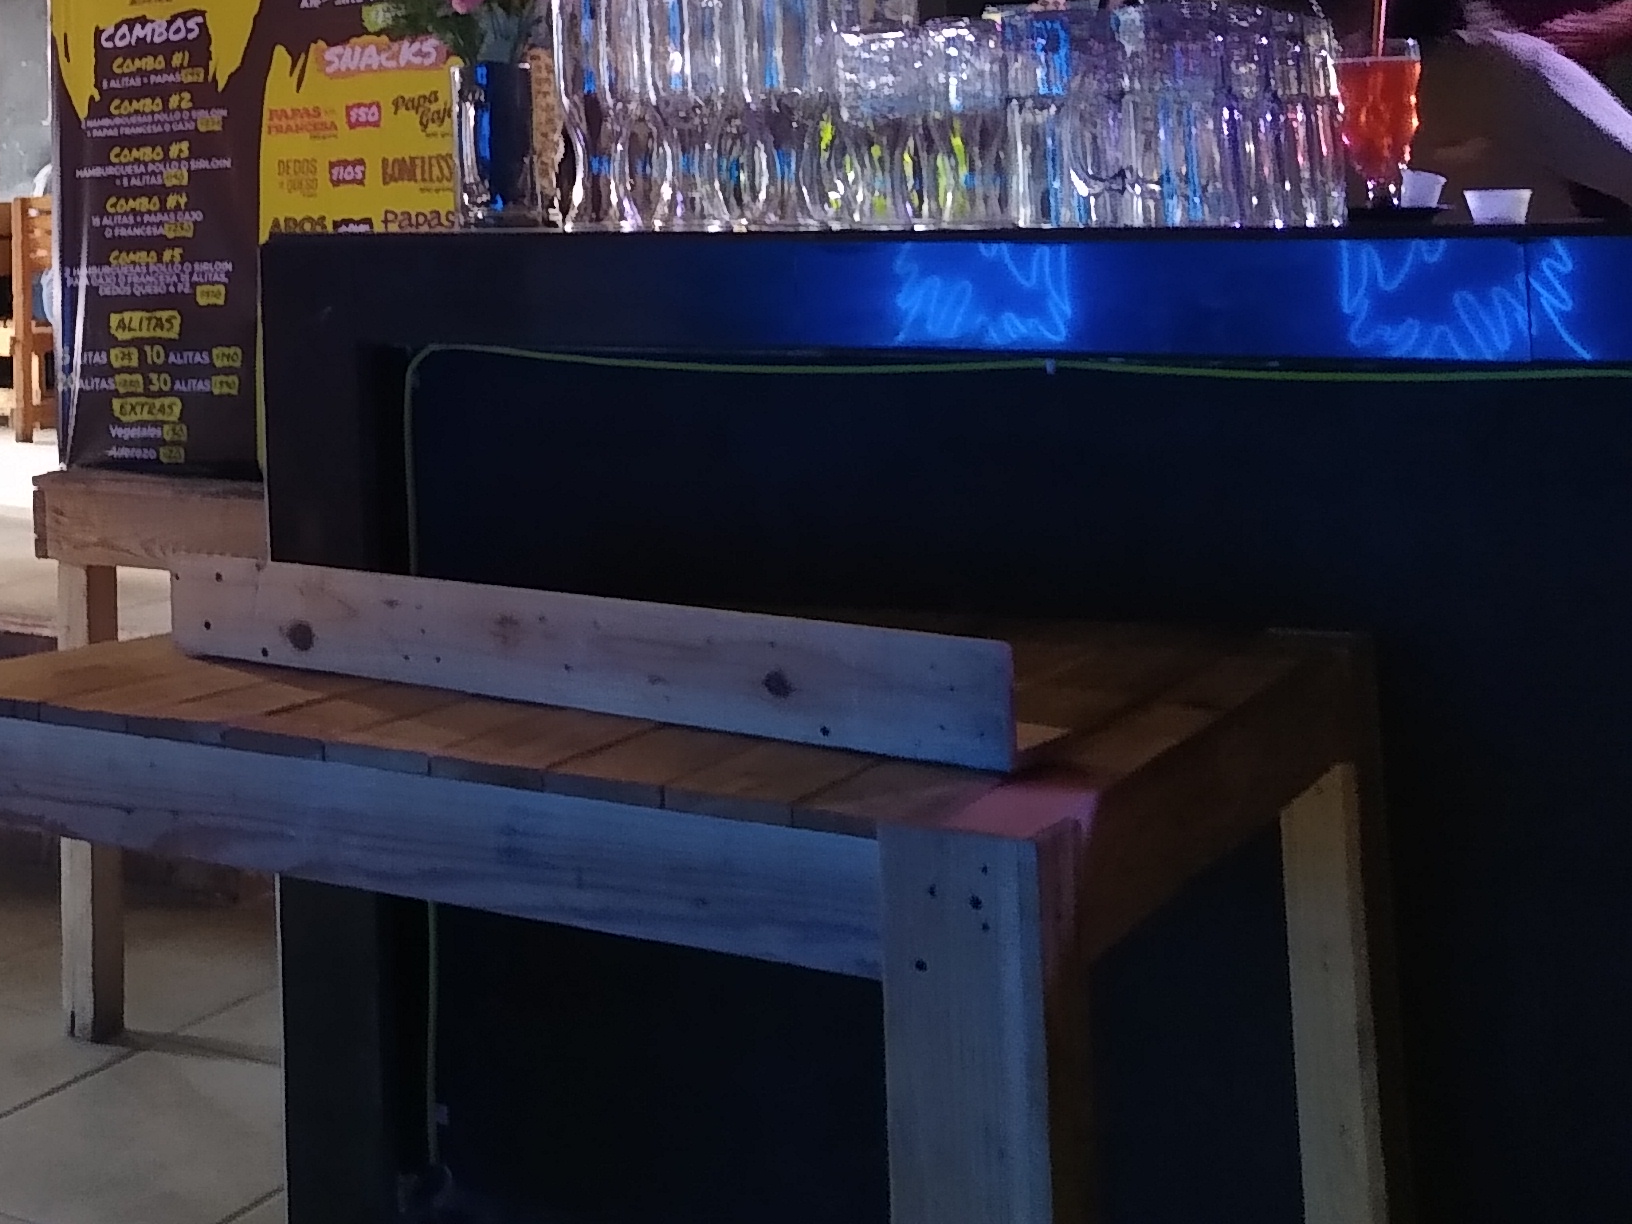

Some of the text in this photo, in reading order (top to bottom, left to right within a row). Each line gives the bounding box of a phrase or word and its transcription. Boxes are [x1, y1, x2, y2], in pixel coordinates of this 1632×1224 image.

[100, 15, 204, 48] COMBOS
[112, 50, 190, 74] COMBO #1
[323, 37, 440, 74] SNACKS
[109, 75, 142, 89] ALITAS
[110, 91, 193, 115] COMBO #2
[392, 90, 439, 115] Papa
[268, 107, 322, 121] PAPAS
[349, 108, 379, 123] $50
[110, 141, 190, 163] COMBO #3
[277, 158, 317, 176] DEDOS
[381, 153, 454, 186] BONELESS
[130, 174, 163, 187] ALITAS
[106, 192, 188, 213] COMBO #4
[102, 214, 134, 226] ALITAS
[109, 247, 183, 265] COMBO #5
[115, 315, 178, 333] ALITAS
[144, 345, 165, 365] 10
[168, 350, 210, 365] ALITAS
[148, 373, 171, 391] 30
[173, 379, 211, 392] ALITAS
[119, 401, 178, 417] EXTRAS
[109, 424, 162, 441] Vegetales
